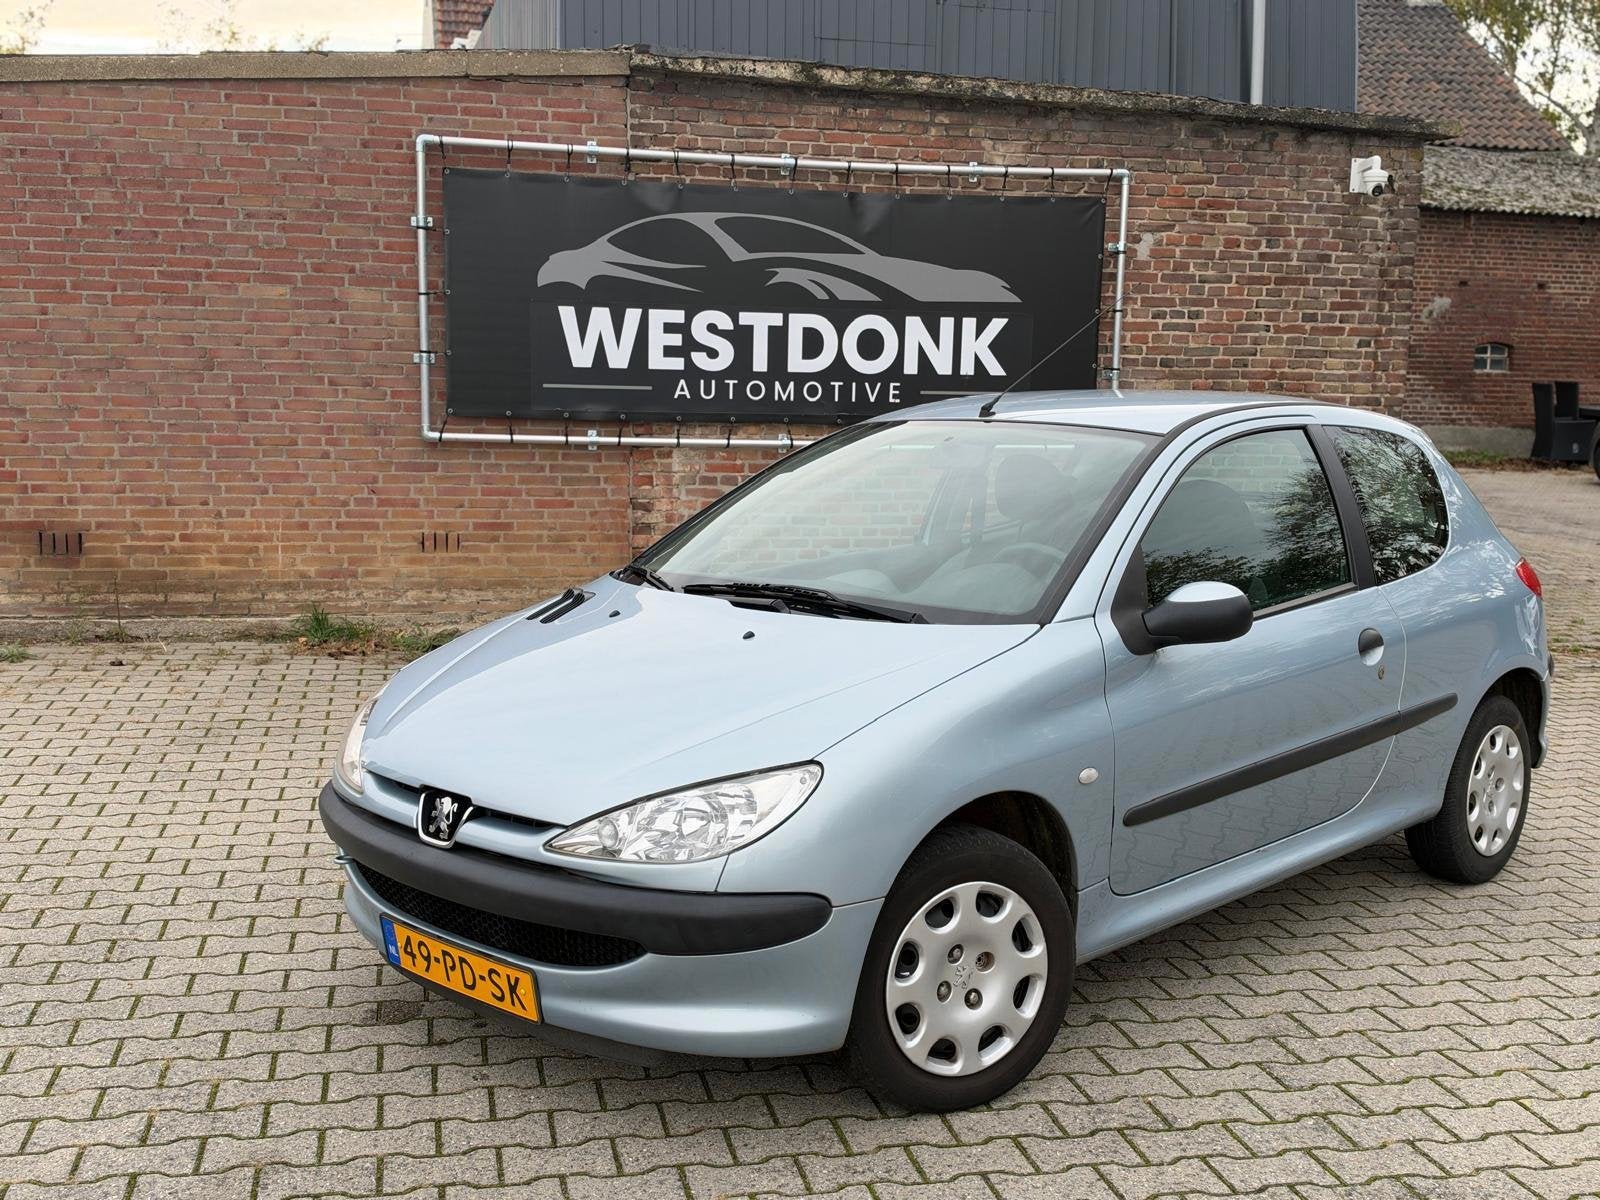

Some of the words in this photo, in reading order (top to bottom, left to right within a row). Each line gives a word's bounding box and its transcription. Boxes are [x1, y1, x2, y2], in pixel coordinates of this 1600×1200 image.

[558, 305, 1008, 376] WESTDONK
[674, 379, 901, 404] AUTOMOTIVE
[402, 935, 527, 1011] 49-PD-SK
